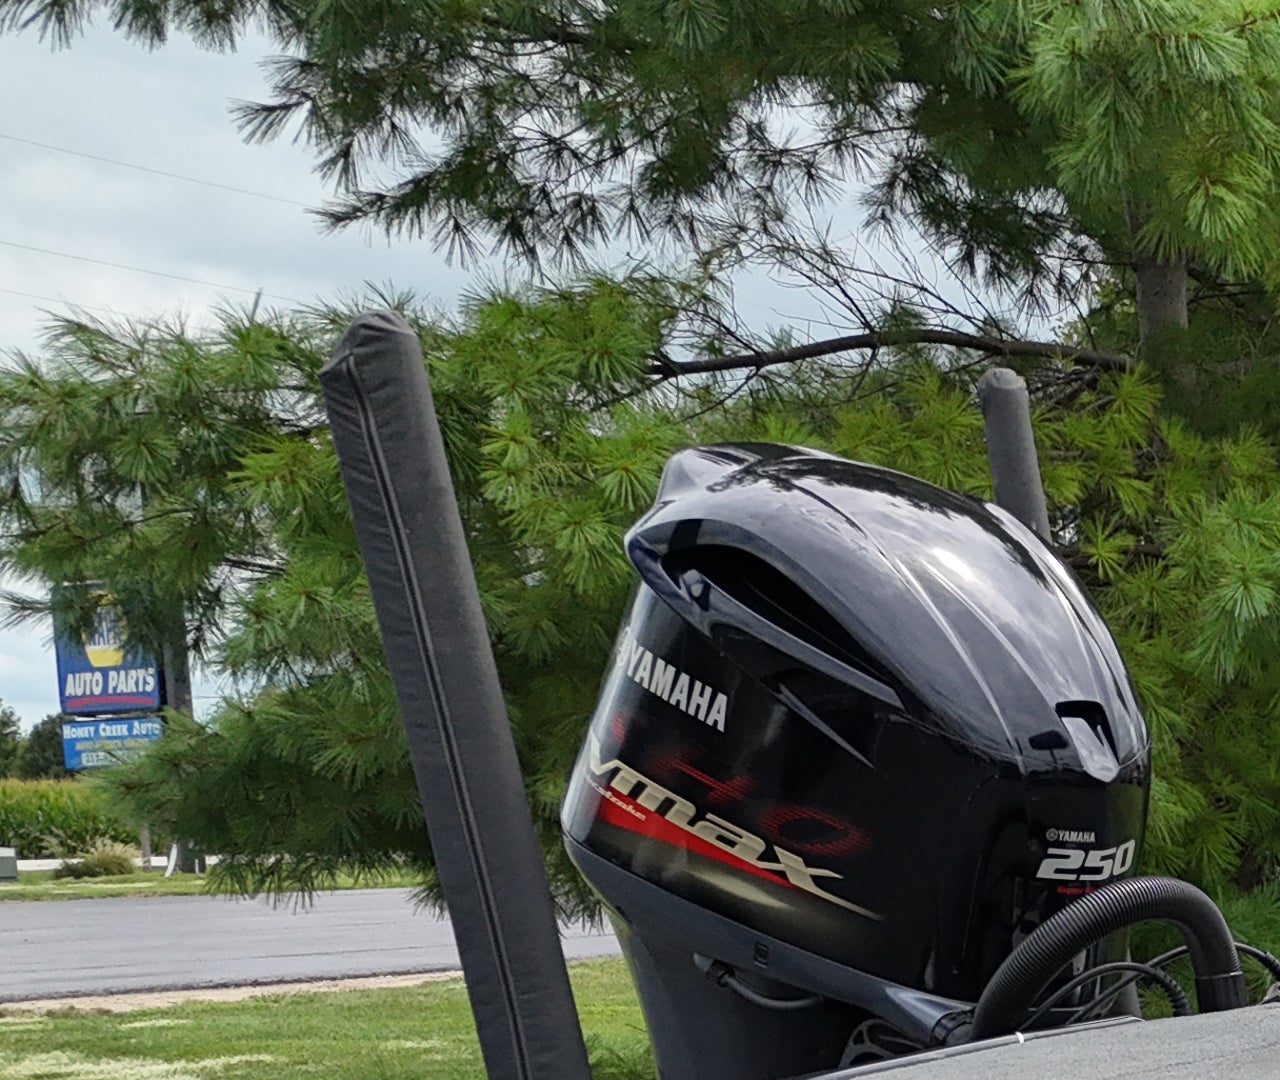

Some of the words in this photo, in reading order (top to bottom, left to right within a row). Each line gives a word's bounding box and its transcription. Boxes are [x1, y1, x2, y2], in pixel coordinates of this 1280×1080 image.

[65, 671, 103, 697] AUTO
[108, 668, 156, 694] PARTS
[627, 640, 728, 732] YAMAHA
[1059, 830, 1095, 843] YAMAHA
[1036, 840, 1135, 880] 250
